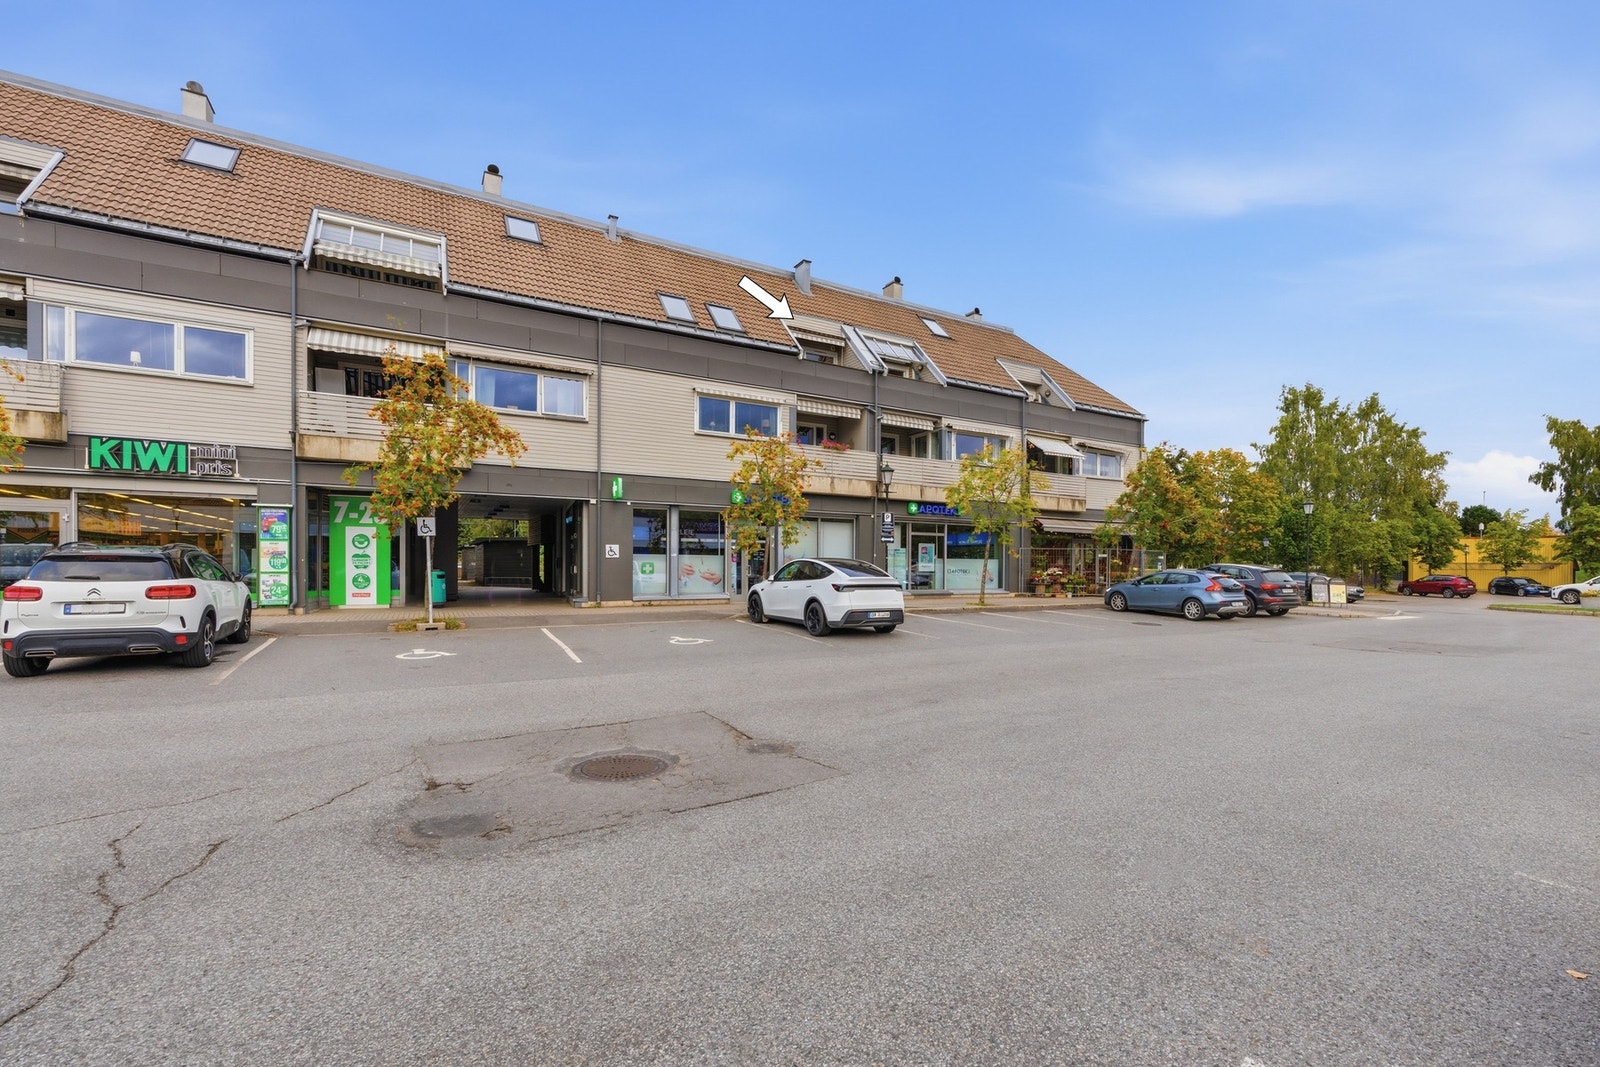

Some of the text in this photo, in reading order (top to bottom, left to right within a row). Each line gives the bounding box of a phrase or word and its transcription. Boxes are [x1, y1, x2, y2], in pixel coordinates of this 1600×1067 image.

[90, 437, 187, 473] KIWI
[196, 444, 237, 458] mini
[196, 459, 233, 475] pris
[333, 500, 388, 525] 7-2
[919, 504, 956, 515] APOTEK
